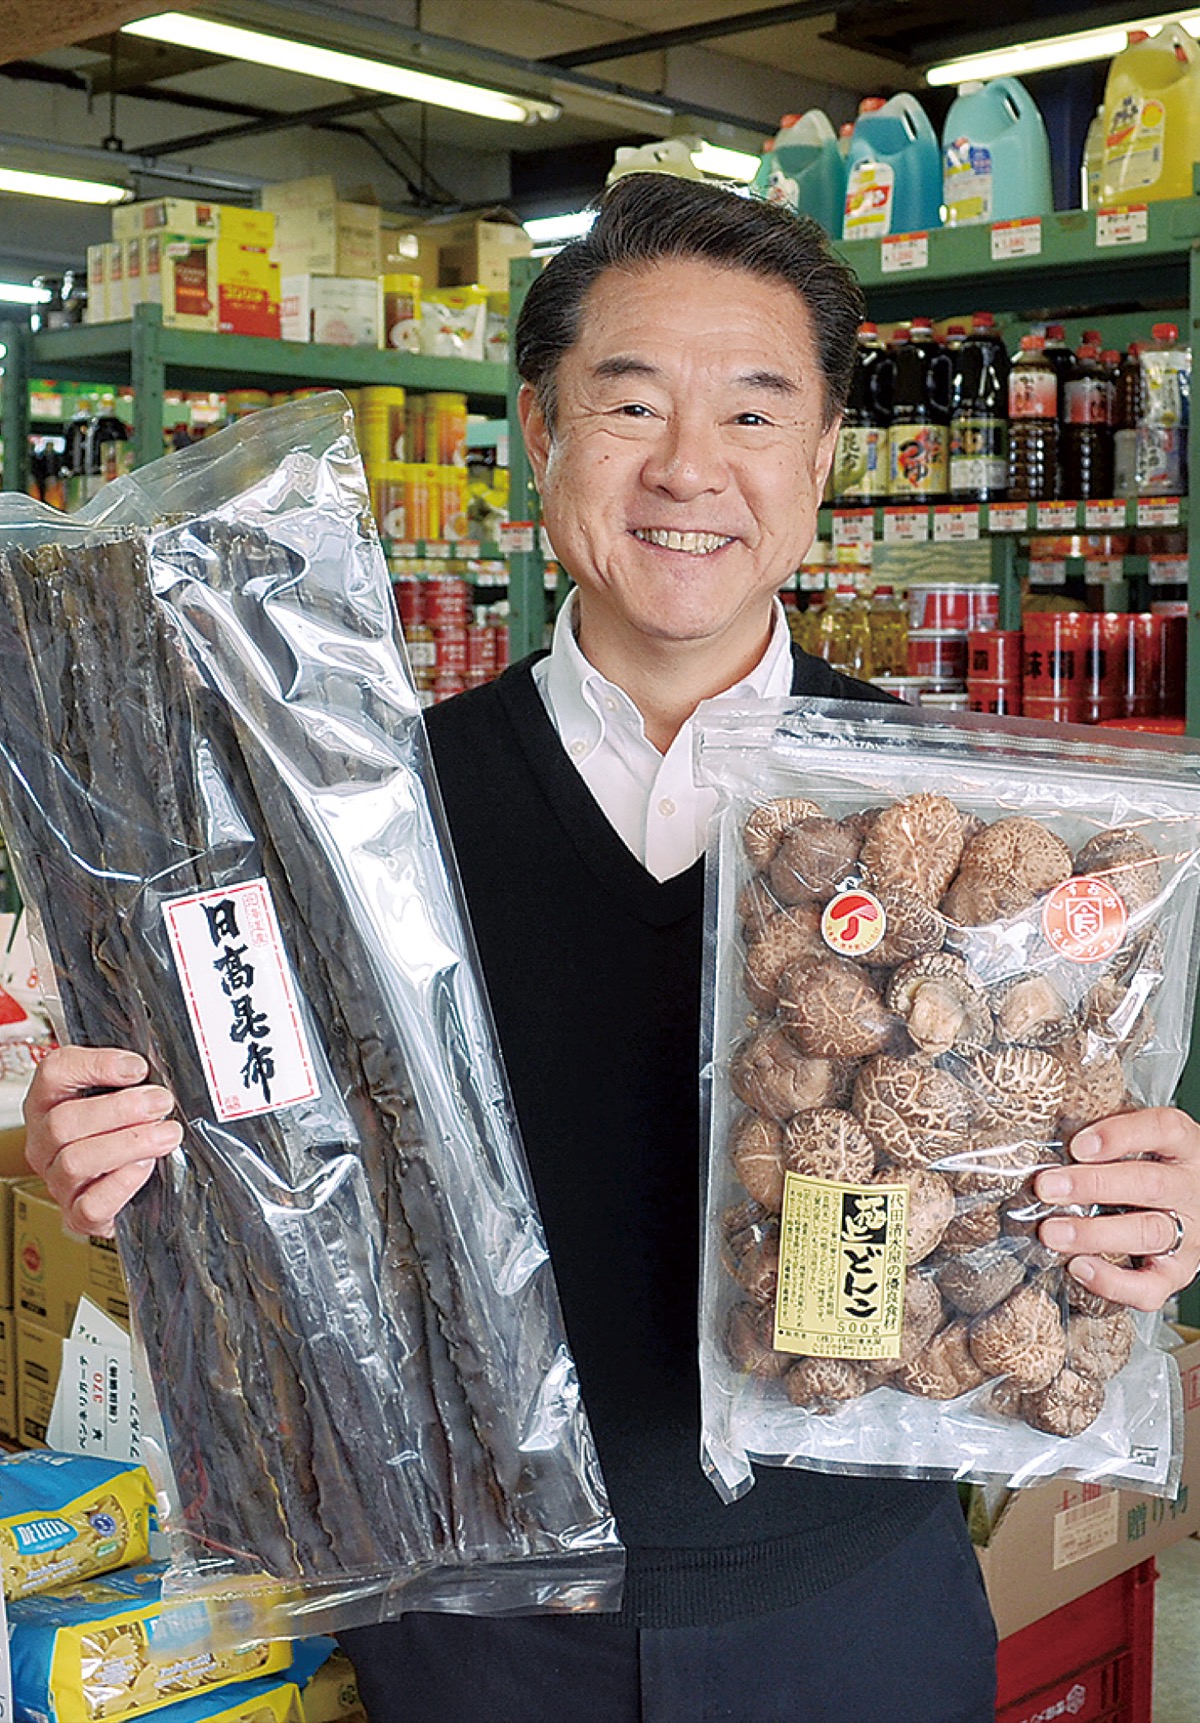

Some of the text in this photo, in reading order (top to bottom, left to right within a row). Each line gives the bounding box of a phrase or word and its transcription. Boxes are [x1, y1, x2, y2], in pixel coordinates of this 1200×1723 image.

[199, 898, 276, 1104] 日高昆布
[92, 1371, 103, 1404] 370
